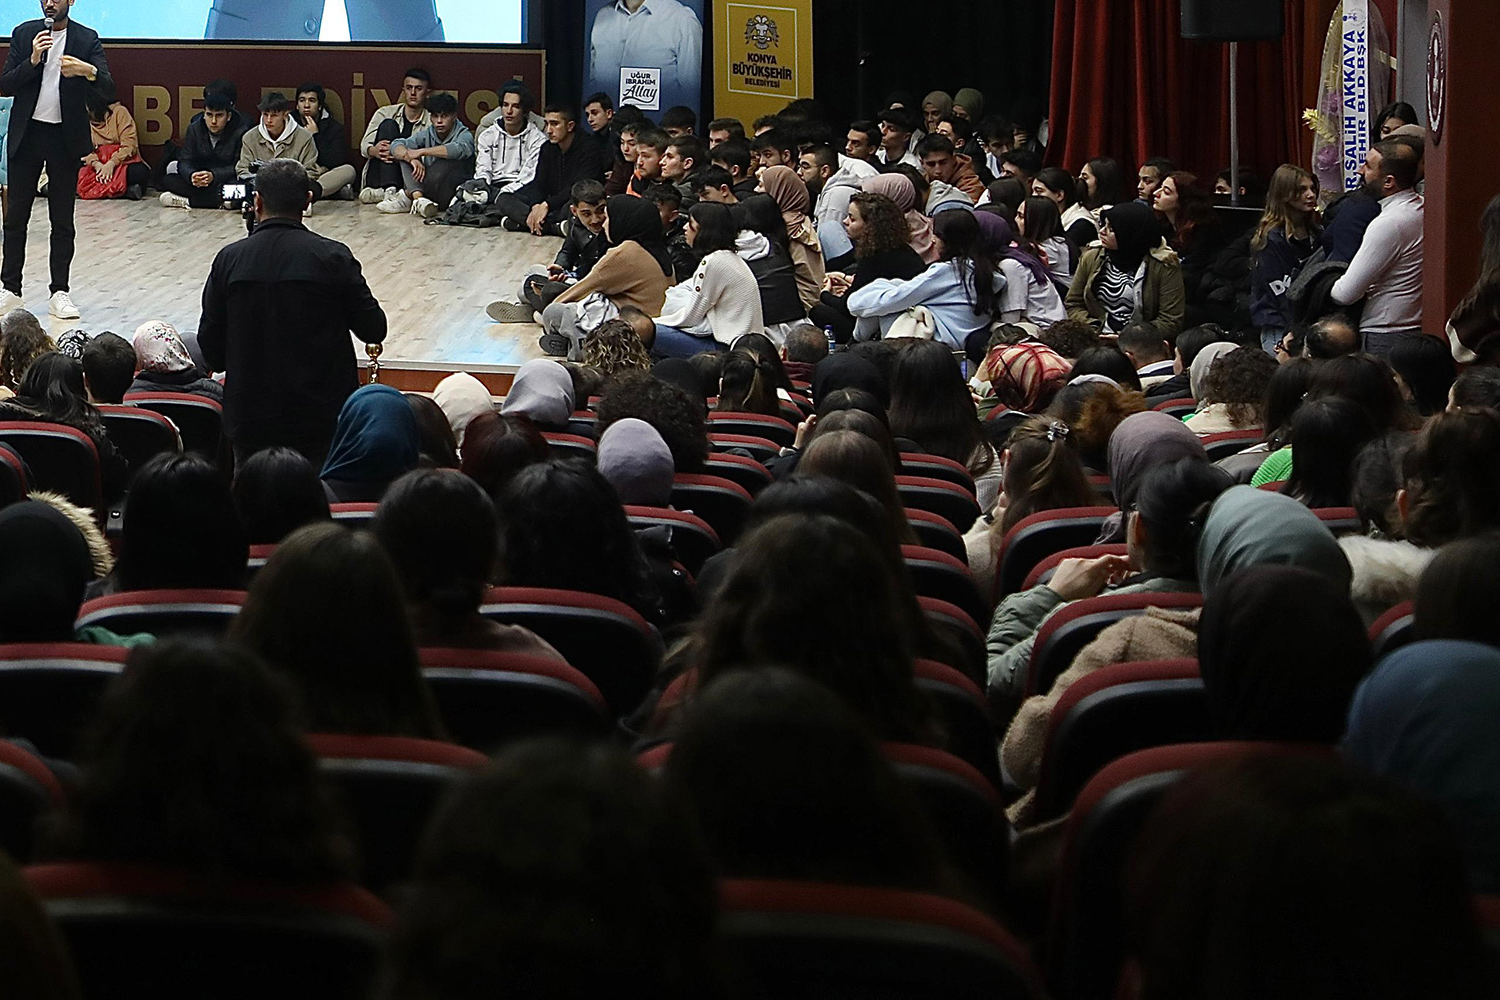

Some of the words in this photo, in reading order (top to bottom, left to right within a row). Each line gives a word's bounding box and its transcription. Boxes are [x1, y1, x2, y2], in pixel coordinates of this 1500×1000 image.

[747, 52, 778, 65] KONYA
[630, 71, 651, 80] UĞUR
[732, 61, 793, 81] BÜYÜKŞEHİR
[1343, 29, 1356, 111] AKKAYA
